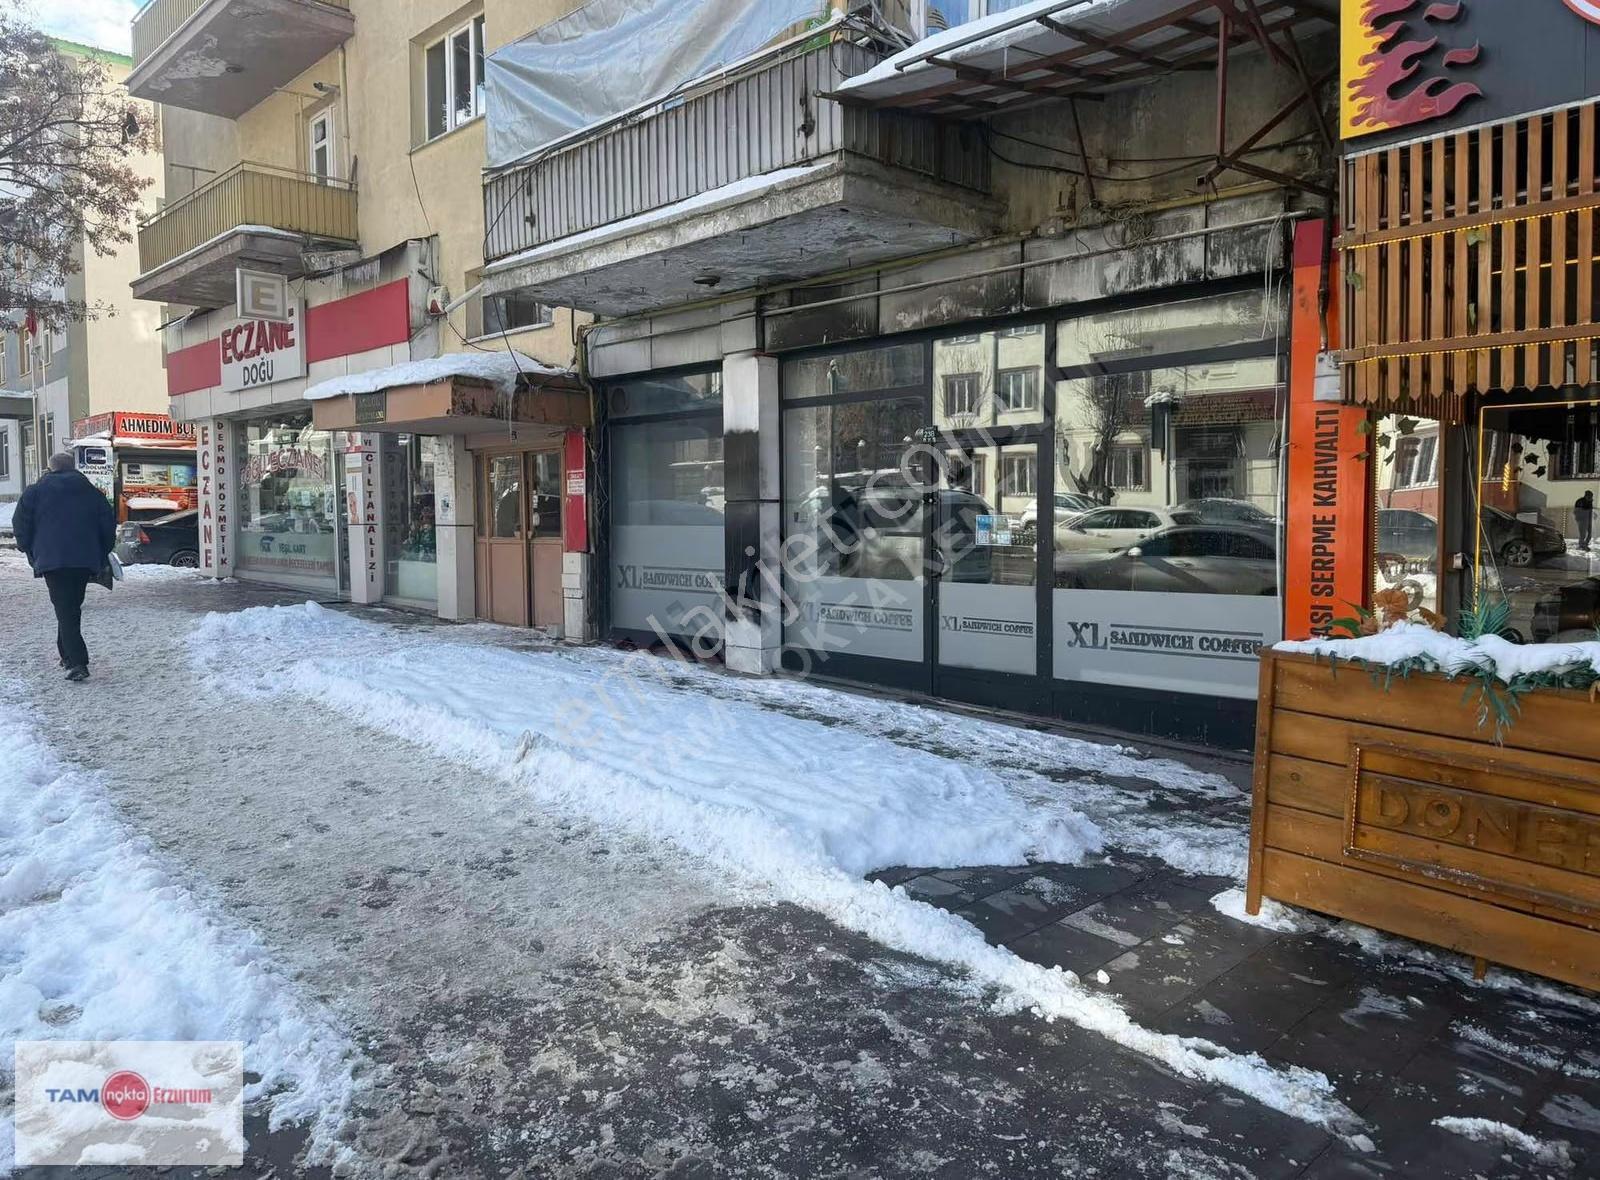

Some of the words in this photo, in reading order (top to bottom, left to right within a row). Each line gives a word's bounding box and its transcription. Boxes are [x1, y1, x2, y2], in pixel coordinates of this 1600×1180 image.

[221, 308, 295, 365] ECZANE
[243, 357, 274, 386] DOĞU
[120, 416, 173, 434] AHMEDİM
[216, 421, 226, 475] DERMO
[1313, 408, 1340, 507] KAHVALTI
[201, 426, 213, 568] ECZANE
[218, 483, 228, 566] KOZMETİK
[617, 565, 642, 589] XL
[643, 571, 692, 587] SANDWICH
[1310, 513, 1336, 598] SERPME
[941, 615, 961, 632] XL
[962, 620, 1002, 632] SANDWICH
[1003, 623, 1034, 635] COFFEE
[1067, 621, 1108, 650] XL
[1110, 630, 1194, 650] SANDWICH
[1199, 636, 1264, 656] COFFEE
